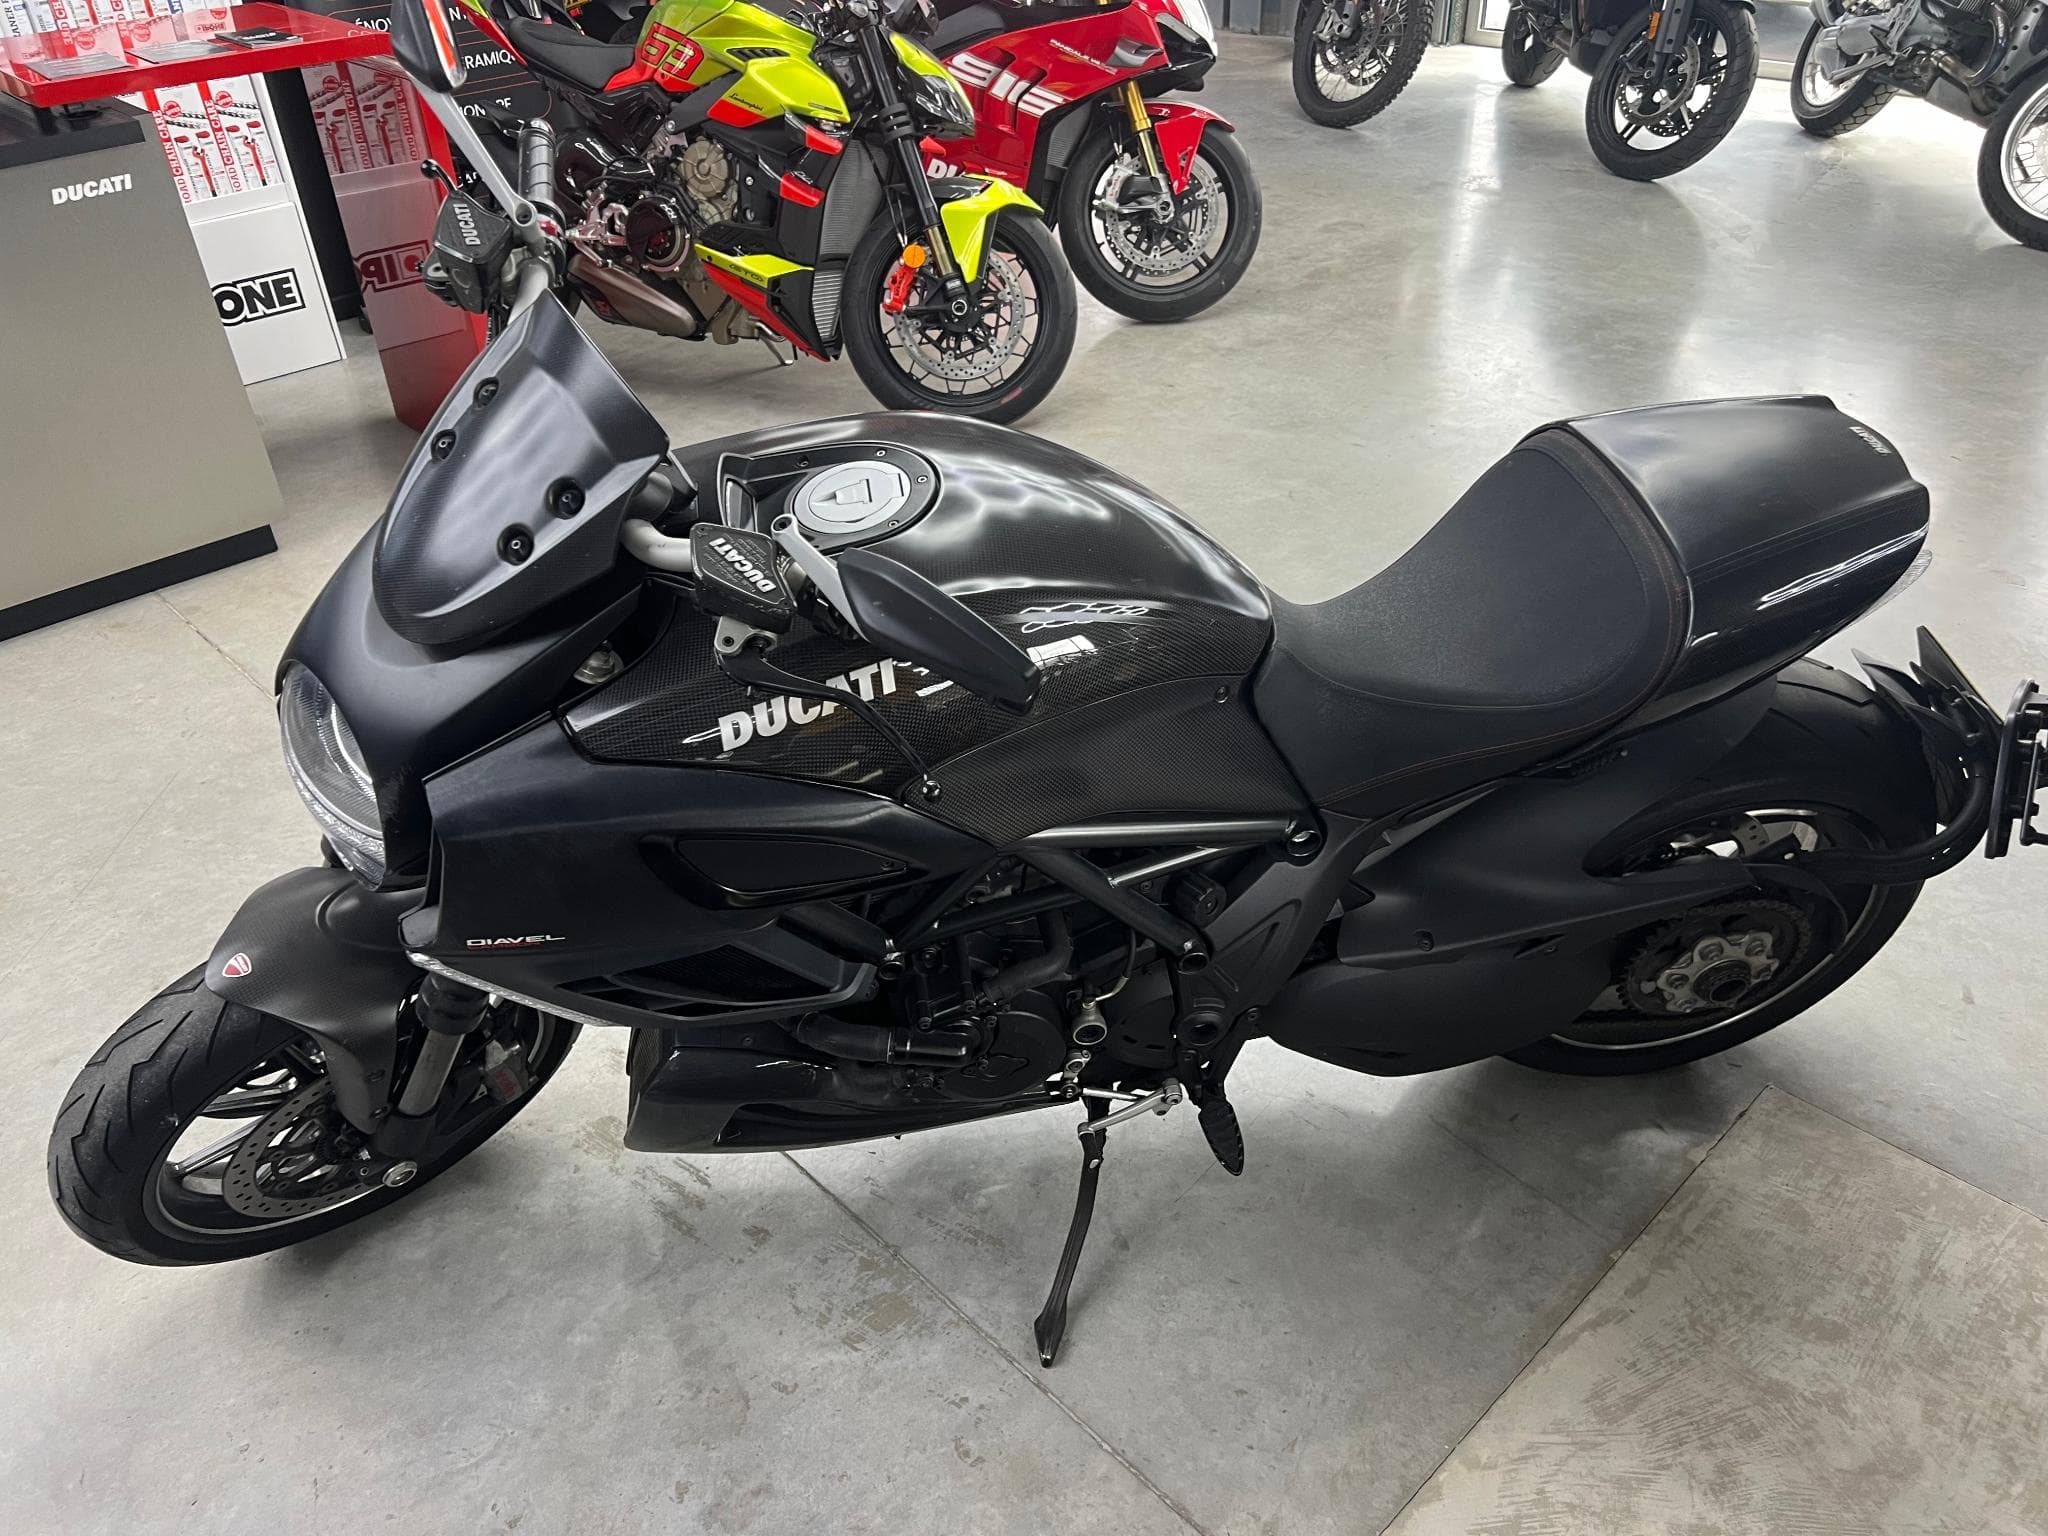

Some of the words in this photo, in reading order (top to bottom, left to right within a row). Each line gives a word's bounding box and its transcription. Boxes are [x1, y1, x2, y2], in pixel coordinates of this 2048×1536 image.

[463, 49, 516, 69] RAMIQ
[640, 21, 705, 81] 63
[152, 110, 169, 138] CARE
[205, 99, 221, 128] CARE
[163, 141, 182, 175] CHAIN
[216, 131, 234, 165] CHAIN
[51, 174, 132, 205] DUCATI
[453, 203, 481, 245] DUCATI
[709, 538, 777, 592] DUCATI
[466, 934, 566, 947] DIAVEL
